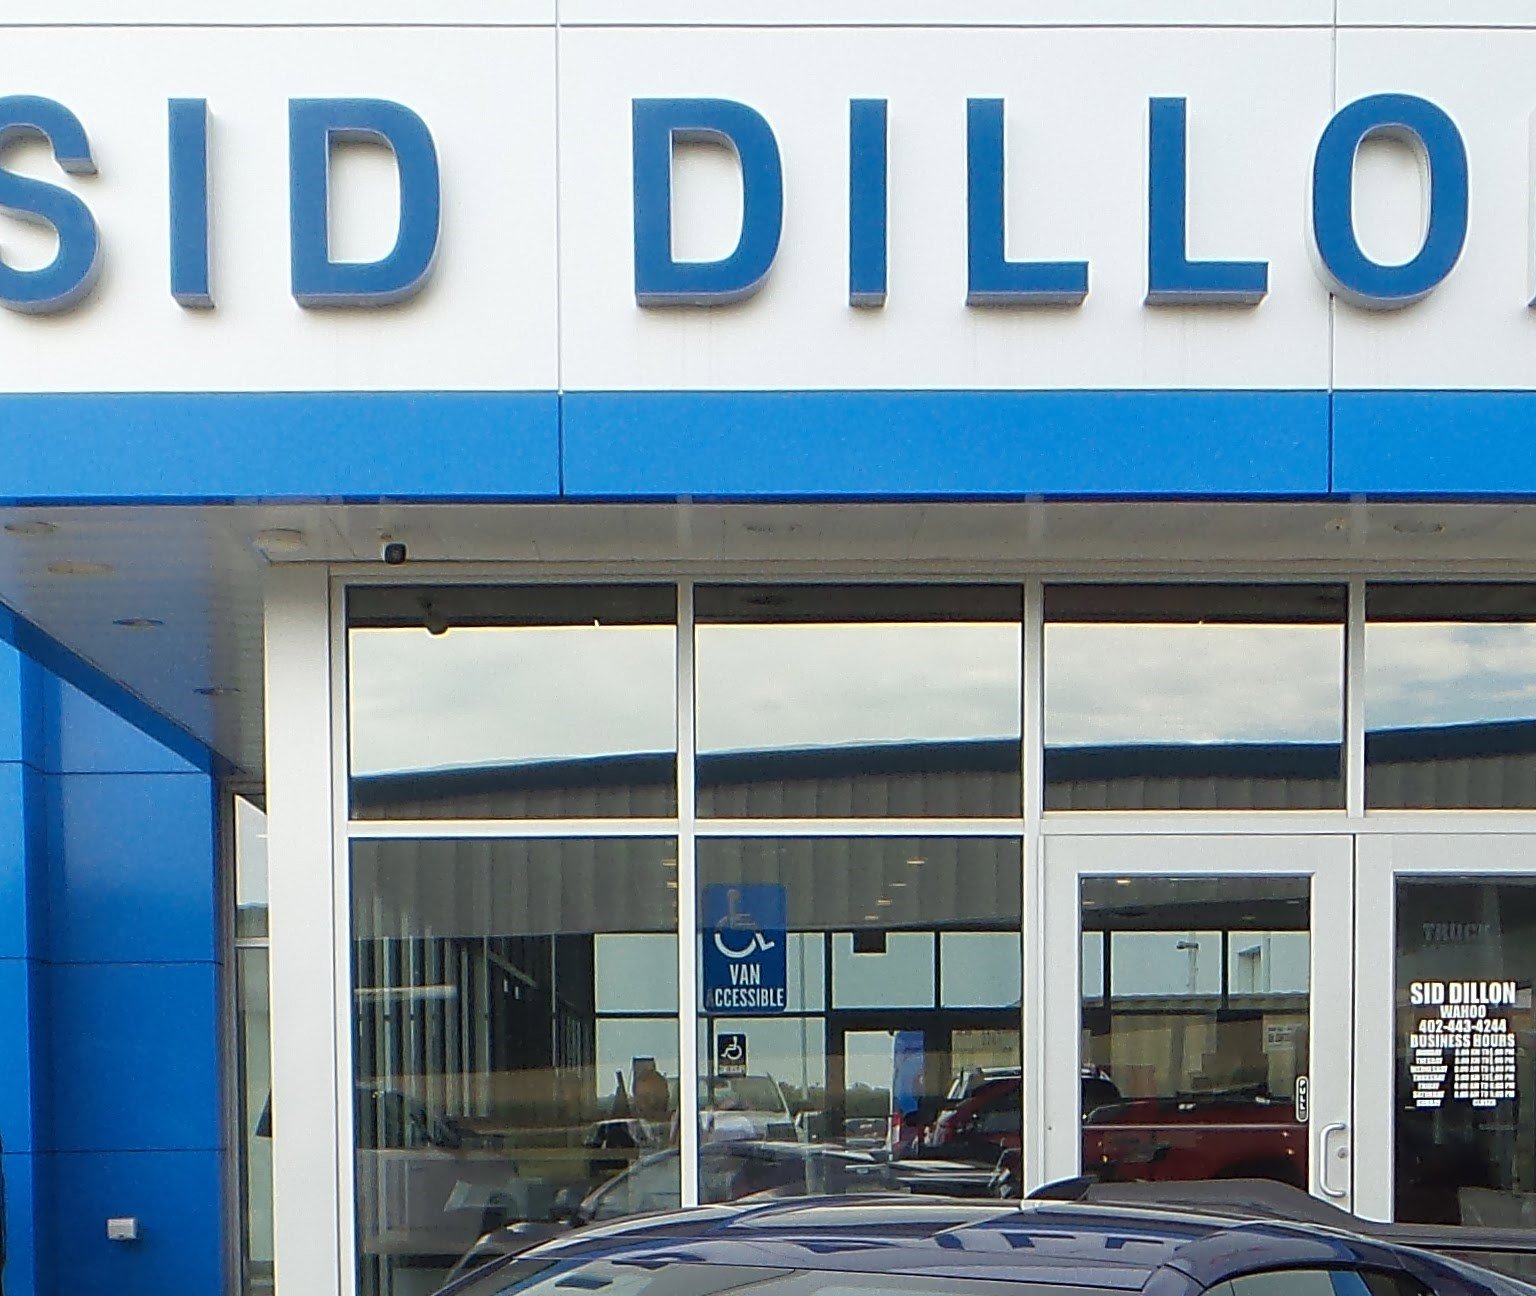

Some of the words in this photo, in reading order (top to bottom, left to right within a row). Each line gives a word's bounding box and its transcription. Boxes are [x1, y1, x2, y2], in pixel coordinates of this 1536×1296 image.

[729, 963, 760, 986] VAN
[1409, 981, 1445, 1005] SID
[1448, 981, 1516, 1004] DILLON
[1439, 1004, 1487, 1019] WAHOO
[1418, 1018, 1507, 1033] 402-443-4244
[1410, 1033, 1471, 1049] BUSINESS
[1472, 1032, 1515, 1048] HOURS
